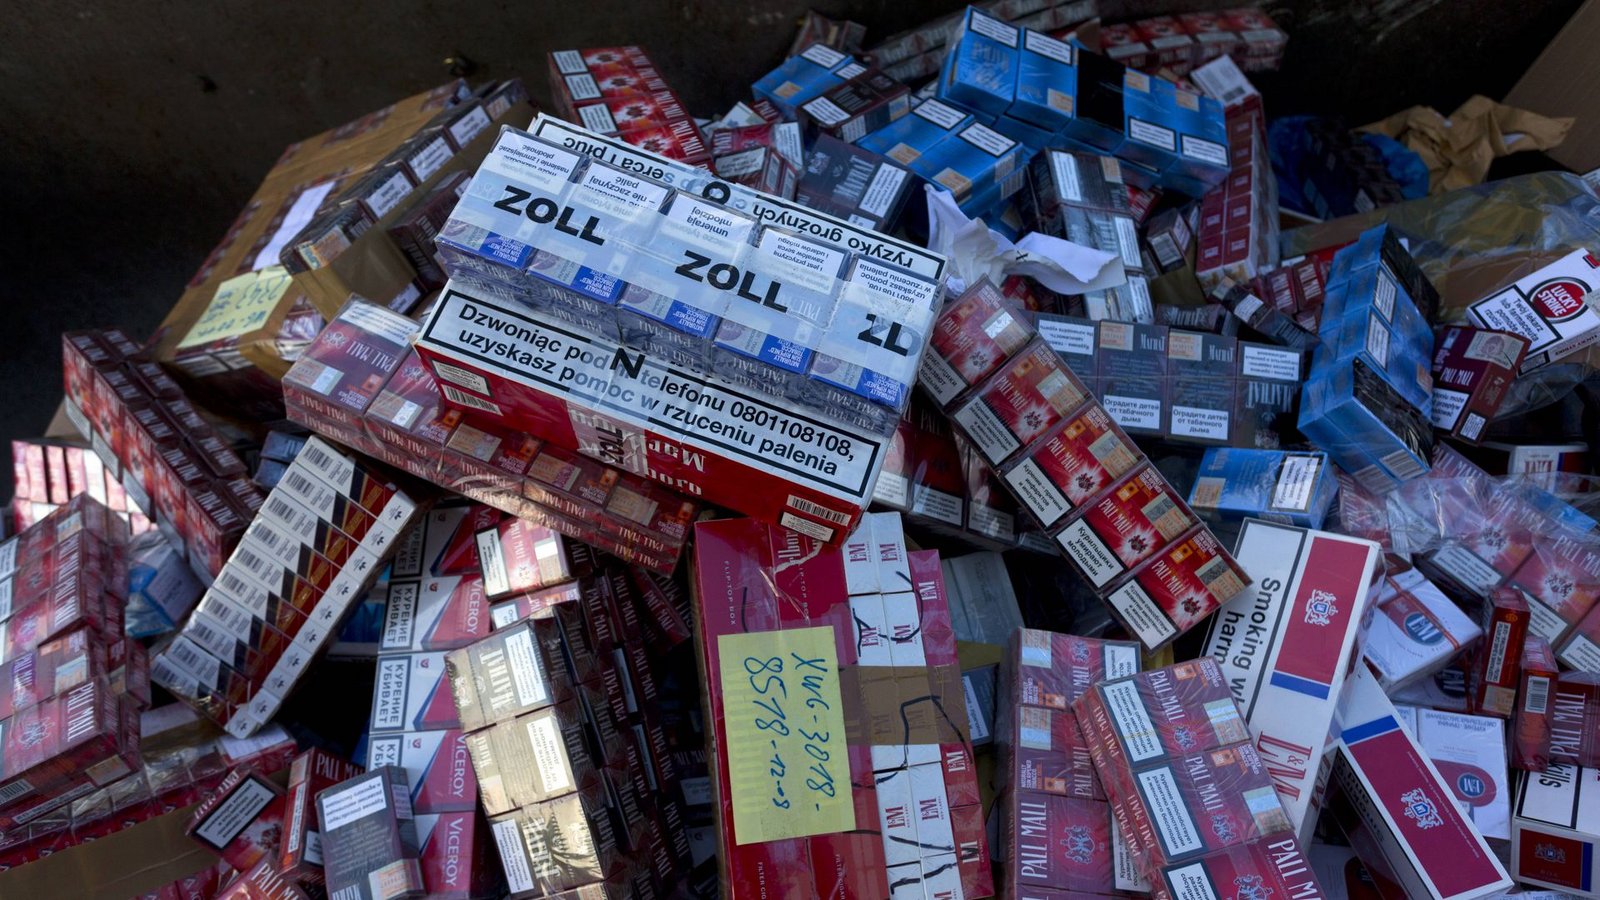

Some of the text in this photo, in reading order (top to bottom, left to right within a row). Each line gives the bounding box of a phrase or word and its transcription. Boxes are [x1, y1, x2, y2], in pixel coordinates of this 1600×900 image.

[560, 133, 607, 162] płuc
[668, 117, 705, 158] PALL MALL
[613, 174, 639, 191] palić
[618, 154, 677, 186] serca
[587, 173, 648, 203] nie zaczynaj
[490, 182, 611, 246] ZOLL
[684, 214, 730, 238] umierają
[689, 205, 733, 228] młodziej
[748, 200, 844, 247] groźnych
[844, 231, 916, 270] ryzyko
[672, 248, 796, 313] ZOLL
[858, 261, 888, 278] palenia
[859, 270, 927, 300] uzyskasz pomoc
[887, 272, 924, 290] rzuceniu
[1534, 288, 1568, 319] STRIKE
[1548, 282, 1580, 312] LUCKY
[1482, 307, 1503, 327] rzucić
[1493, 306, 1521, 333] pomoże
[1499, 297, 1543, 342] lub farmaceuta
[1510, 297, 1546, 333] Twój lekarz
[454, 300, 607, 373] Dzwoniąc pod
[345, 338, 398, 373] PALL MALL
[994, 375, 1028, 411] PALL MALL
[1439, 365, 1474, 387] PALL MALL
[455, 326, 840, 476] uzyskasz pomoc w rzuceniu palenia
[637, 368, 860, 461] telefonu 0801108108,
[1104, 398, 1159, 410] Оградите детей
[1119, 407, 1154, 418] табачного
[1172, 409, 1227, 421] Оградите детей
[1121, 415, 1141, 423] дыма
[1188, 418, 1222, 428] табачного
[1189, 425, 1209, 434] дыма
[1045, 436, 1080, 473] PALL MALL
[1097, 497, 1132, 535] PALL MALL
[847, 542, 867, 562] L&M
[879, 542, 897, 561] L&M
[1065, 539, 1099, 577] молодыми
[1074, 537, 1103, 569] умирают
[1075, 526, 1115, 570] Курильщики
[1551, 533, 1583, 563] PALL
[918, 580, 937, 600] L&M
[1150, 558, 1186, 597] PALL MALL
[384, 587, 400, 644] УБИВАЕТ
[396, 586, 412, 643] КУРЕНИЕ
[583, 587, 611, 641] PALL MALL
[611, 574, 638, 626] PALL MALL
[1231, 574, 1282, 673] Smoking
[1404, 616, 1441, 645] L&M
[630, 647, 659, 701] PALL MALL
[1072, 664, 1089, 688] MALL
[377, 663, 392, 724] УБИВАЕТ
[388, 663, 404, 723] КУРЕНИЕ
[1148, 668, 1185, 723] PALL MALL
[65, 679, 96, 744] PALL MALL
[1091, 704, 1120, 757] PALL MALL
[1548, 724, 1583, 758] PALL
[311, 751, 346, 782] PALL
[946, 750, 966, 772] L&M
[191, 768, 241, 820] PALL MALL
[1074, 771, 1092, 796] PALL
[1184, 753, 1224, 813] PALL MALL
[1461, 777, 1480, 794] L&M
[885, 805, 905, 828] L&M
[919, 797, 939, 820] L&M
[1127, 793, 1155, 848] PALL MALL
[1158, 772, 1193, 845] Курение способствует
[443, 816, 463, 886] VICEROY
[1020, 801, 1047, 877] PALL MALL
[1266, 835, 1307, 883] PALL
